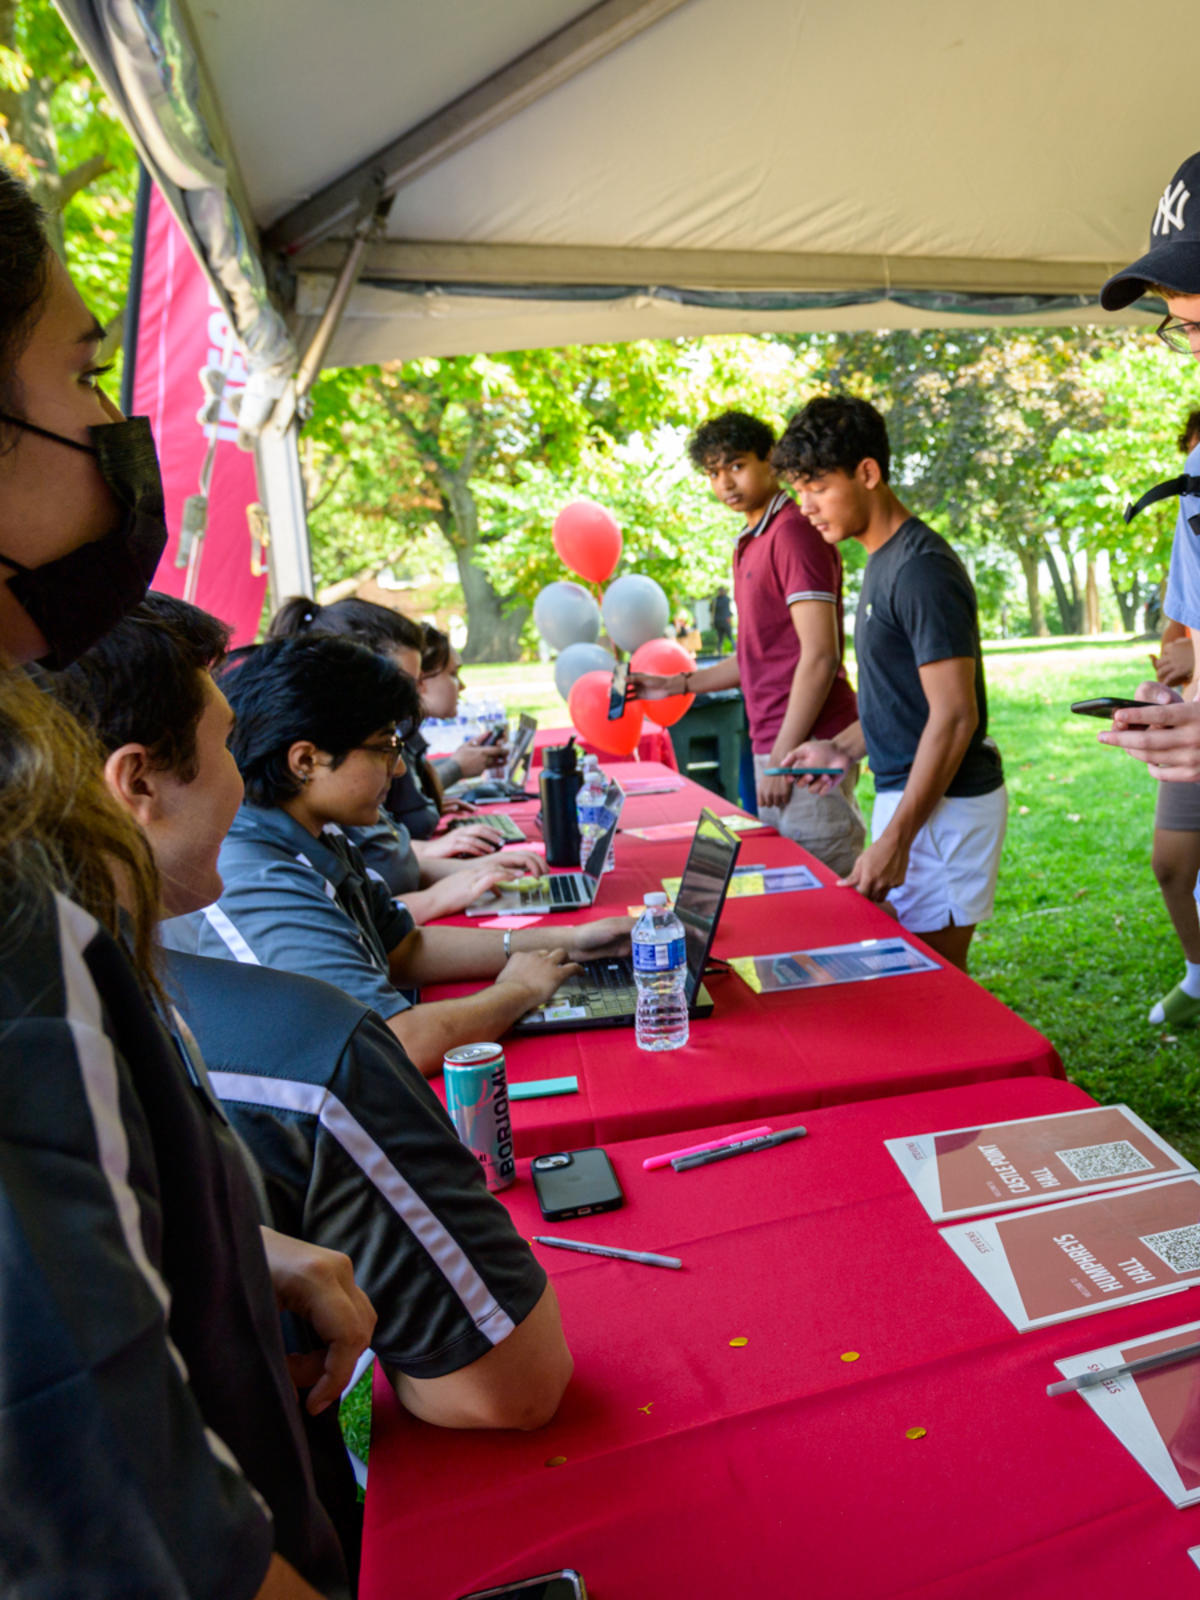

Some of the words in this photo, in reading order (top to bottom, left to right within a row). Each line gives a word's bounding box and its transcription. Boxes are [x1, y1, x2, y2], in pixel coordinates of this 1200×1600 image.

[1152, 179, 1191, 236] NY
[491, 1068, 514, 1177] BORJOMI
[977, 1144, 1010, 1167] POINT
[994, 1165, 1031, 1193] CASTLE
[1030, 1166, 1061, 1188] HALL
[1052, 1233, 1124, 1293] HUMPHREYS
[1117, 1256, 1156, 1284] HALL
[1087, 1363, 1121, 1394] STES
